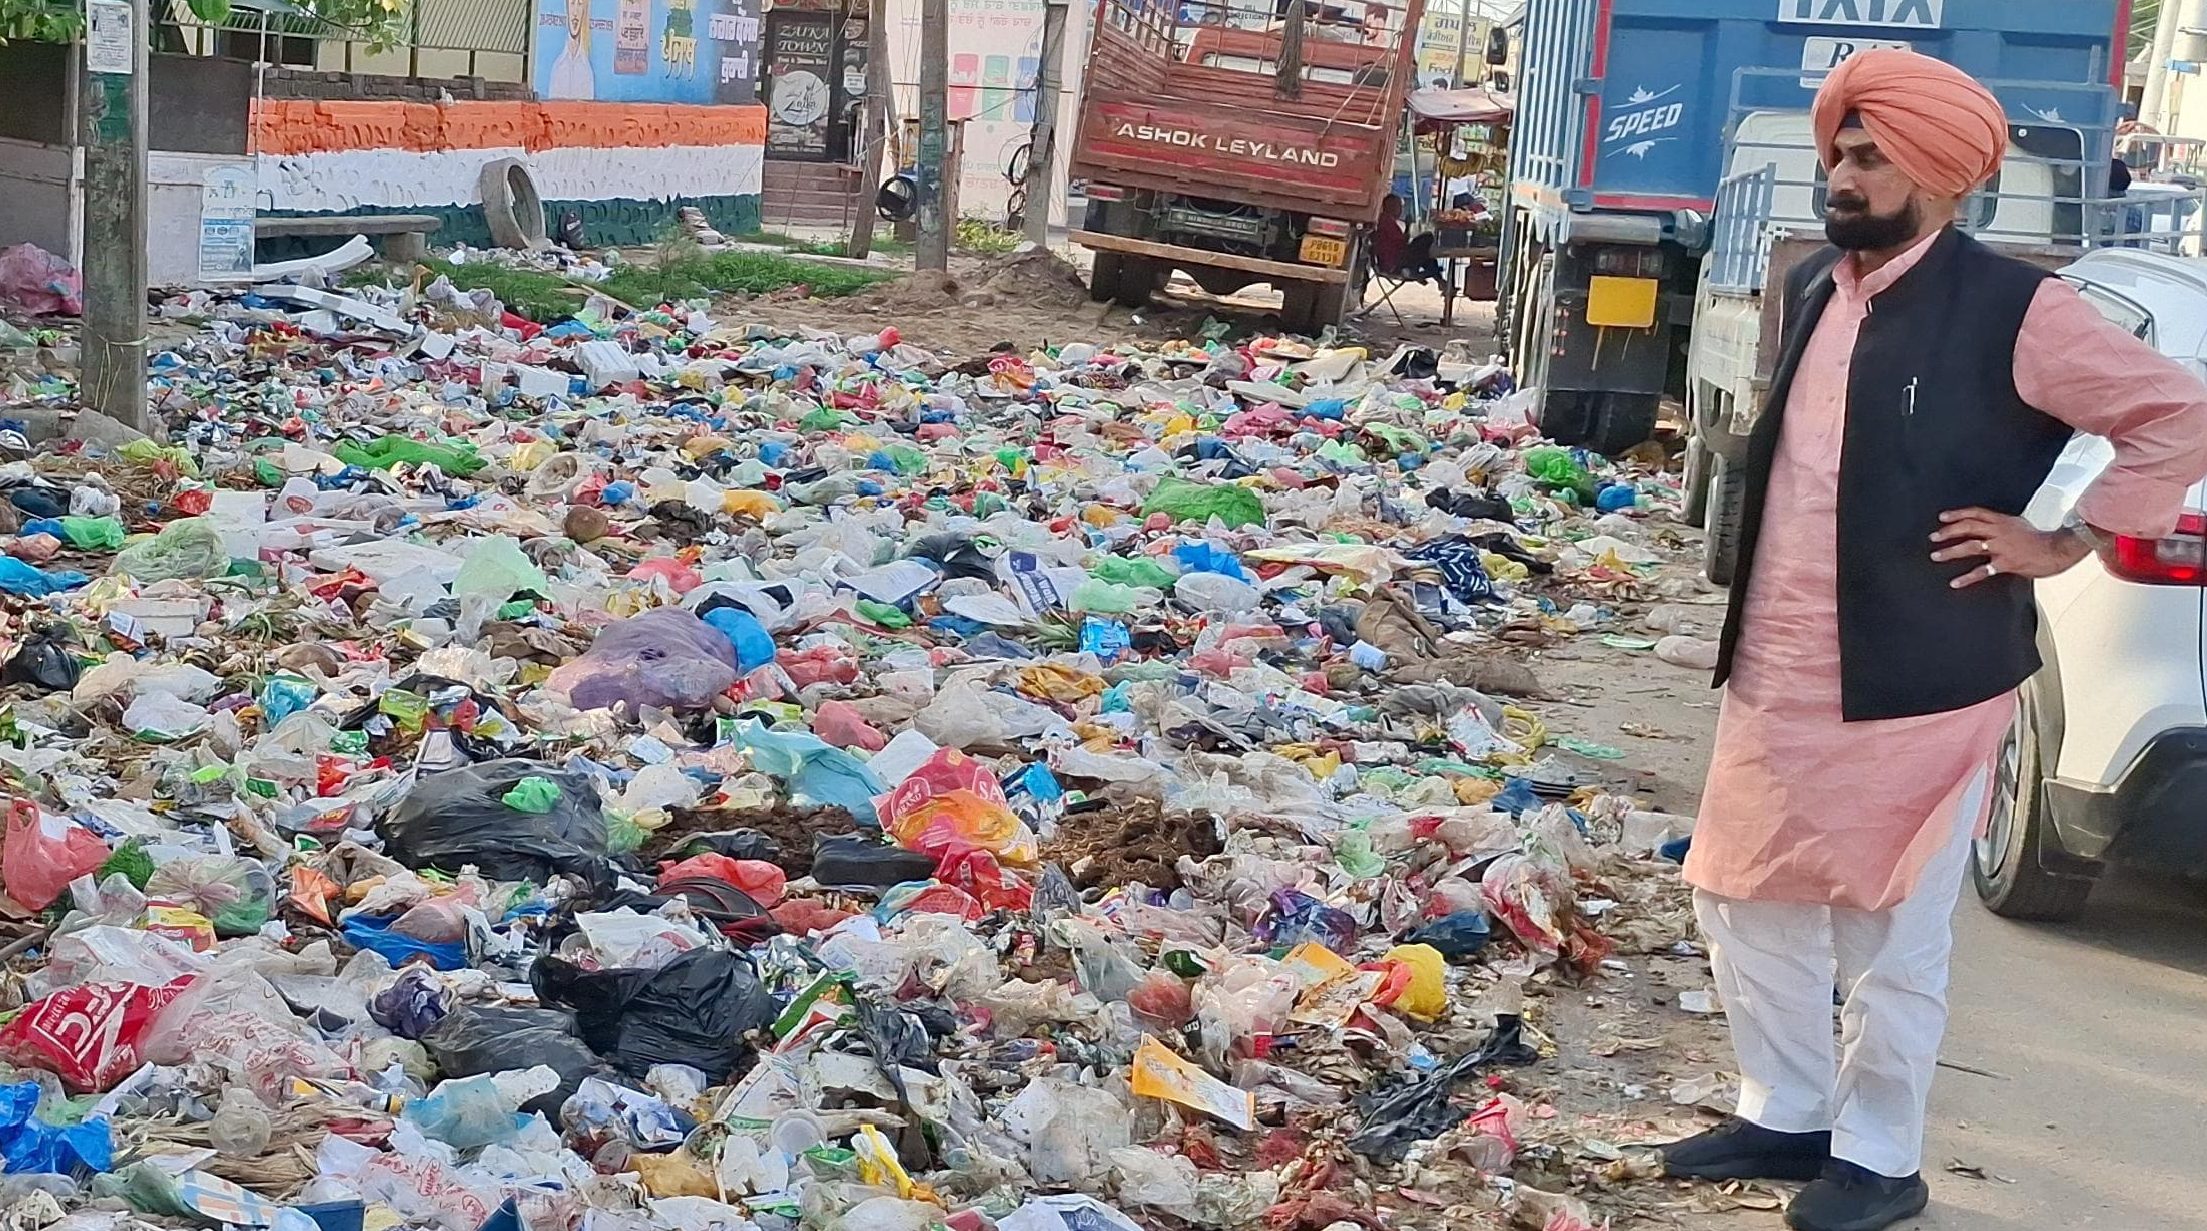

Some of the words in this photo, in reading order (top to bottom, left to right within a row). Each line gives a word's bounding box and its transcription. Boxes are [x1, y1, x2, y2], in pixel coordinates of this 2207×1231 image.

[778, 40, 829, 53] TOWN
[1604, 103, 1683, 142] SPEED
[1117, 123, 1208, 148] ASHOK
[1215, 137, 1338, 167] LEYLAND
